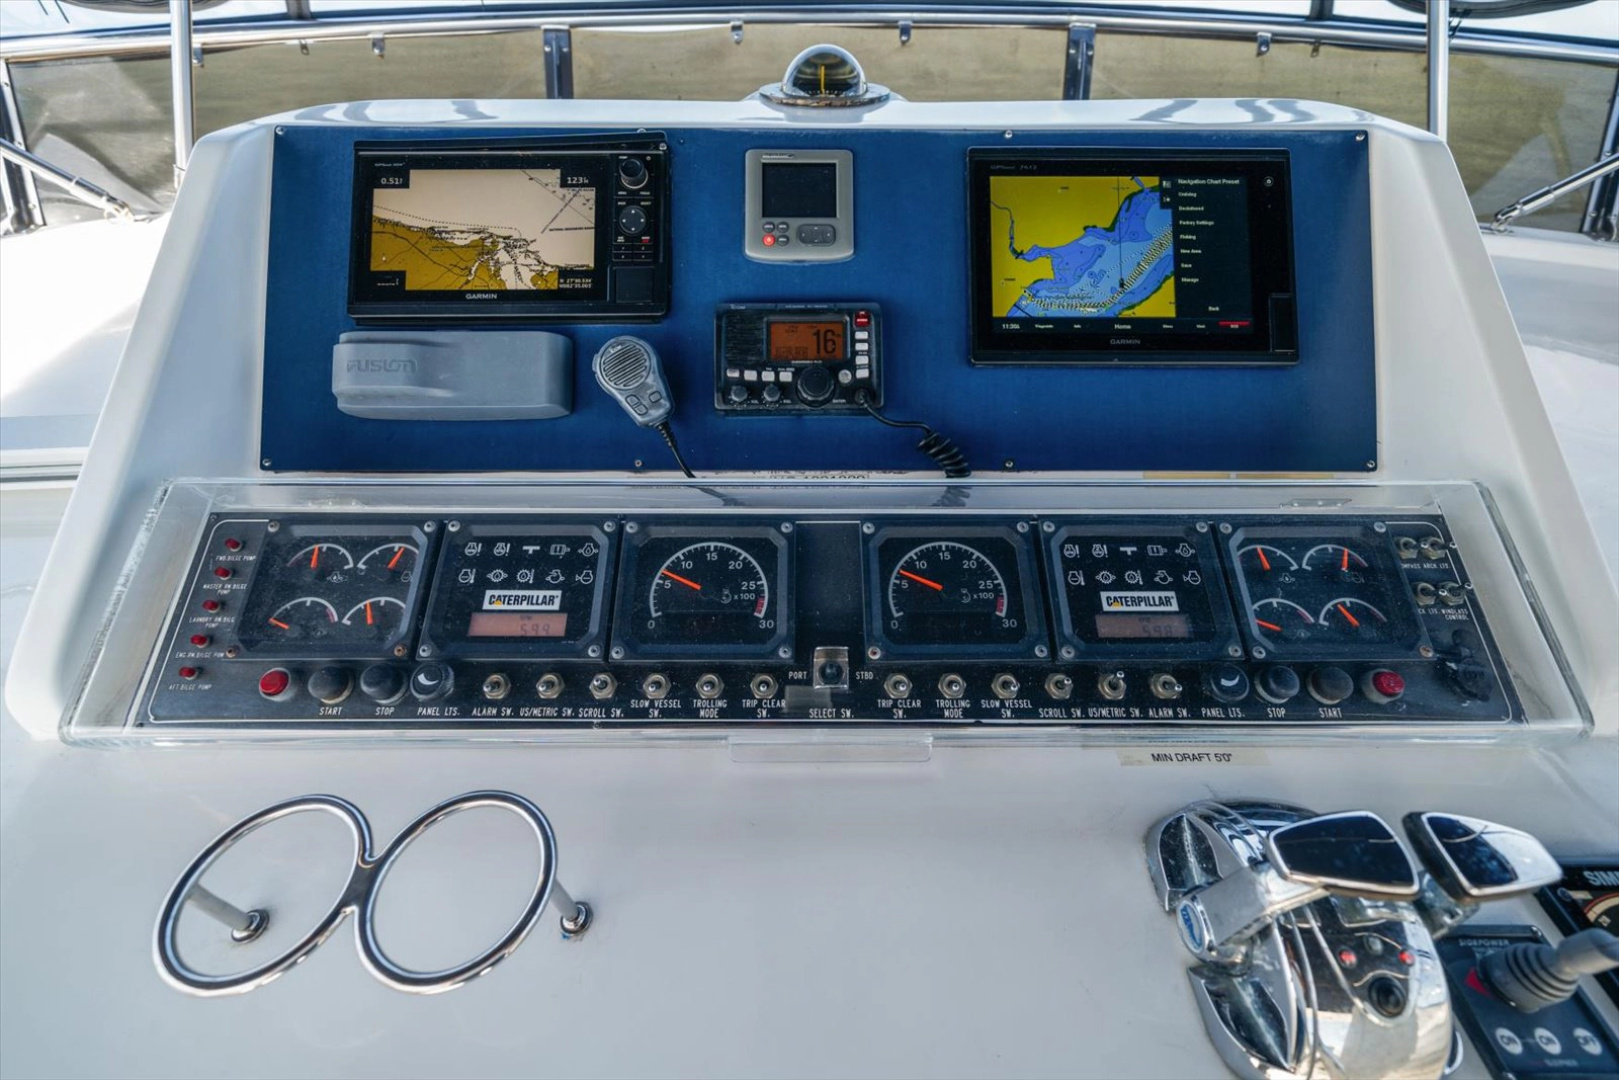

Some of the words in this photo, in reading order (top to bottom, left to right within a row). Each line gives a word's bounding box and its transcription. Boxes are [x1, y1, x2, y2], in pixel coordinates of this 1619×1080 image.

[812, 329, 837, 354] 16
[346, 359, 418, 373] FUSION
[706, 552, 718, 561] 15
[939, 552, 951, 560] 15
[681, 561, 693, 569] 10
[728, 561, 743, 570] 20
[915, 561, 927, 569] 10
[963, 561, 977, 569] 20
[664, 580, 672, 589] 5
[741, 581, 756, 590] 25
[901, 581, 909, 589] 5
[979, 581, 994, 589] 25
[488, 594, 555, 606] CATERPILLAR
[1106, 595, 1173, 607] CATERPILLAR
[647, 620, 655, 629] 0
[759, 620, 774, 629] 30
[891, 620, 899, 629] 0
[1002, 619, 1017, 628] 30
[788, 671, 807, 680] PORT
[856, 671, 874, 680] STBD
[630, 699, 649, 708] SLOW
[654, 699, 682, 708] VESSEL
[693, 699, 727, 708] TROLLING
[742, 699, 759, 708] TRIP
[762, 699, 786, 708] CLEAR
[877, 699, 894, 708] TRIP
[897, 699, 922, 708] CLEAR
[936, 699, 971, 708] TROLLING
[981, 699, 1000, 708] SLOW
[1004, 699, 1033, 708] VESSEL
[319, 707, 343, 716] START
[375, 707, 395, 716] STOP
[417, 707, 440, 716] PANEL
[444, 707, 460, 716] LTS.
[472, 707, 496, 716] ALARM
[501, 707, 514, 717] SW.
[520, 707, 558, 717] US/METRIC
[562, 708, 575, 717] SW.
[578, 708, 606, 718] SCROLL
[610, 708, 624, 718] SW.
[649, 709, 663, 718] SW.
[700, 709, 719, 718] MODE
[757, 709, 771, 718] SW.
[809, 709, 836, 718] SELECT
[840, 709, 855, 718] SW.
[893, 709, 907, 718] SW.
[944, 709, 964, 718] MODE
[1001, 709, 1015, 718] SW.
[1039, 708, 1067, 718] SCROLL
[1071, 708, 1085, 718] SW.
[1088, 707, 1126, 718] US/METRIC
[1130, 708, 1143, 718] SW.
[1149, 708, 1173, 718] ALARM
[1177, 708, 1191, 718] SW.
[1201, 707, 1225, 718] PANEL
[1229, 707, 1245, 718] LTS.
[1267, 708, 1286, 718] STOP
[1319, 708, 1343, 718] START
[1151, 753, 1174, 762] MIN
[1174, 753, 1212, 762] DRAFT
[1458, 939, 1510, 947] SIDEPOWER
[1500, 1035, 1518, 1046] ON
[1538, 1035, 1557, 1046] ON
